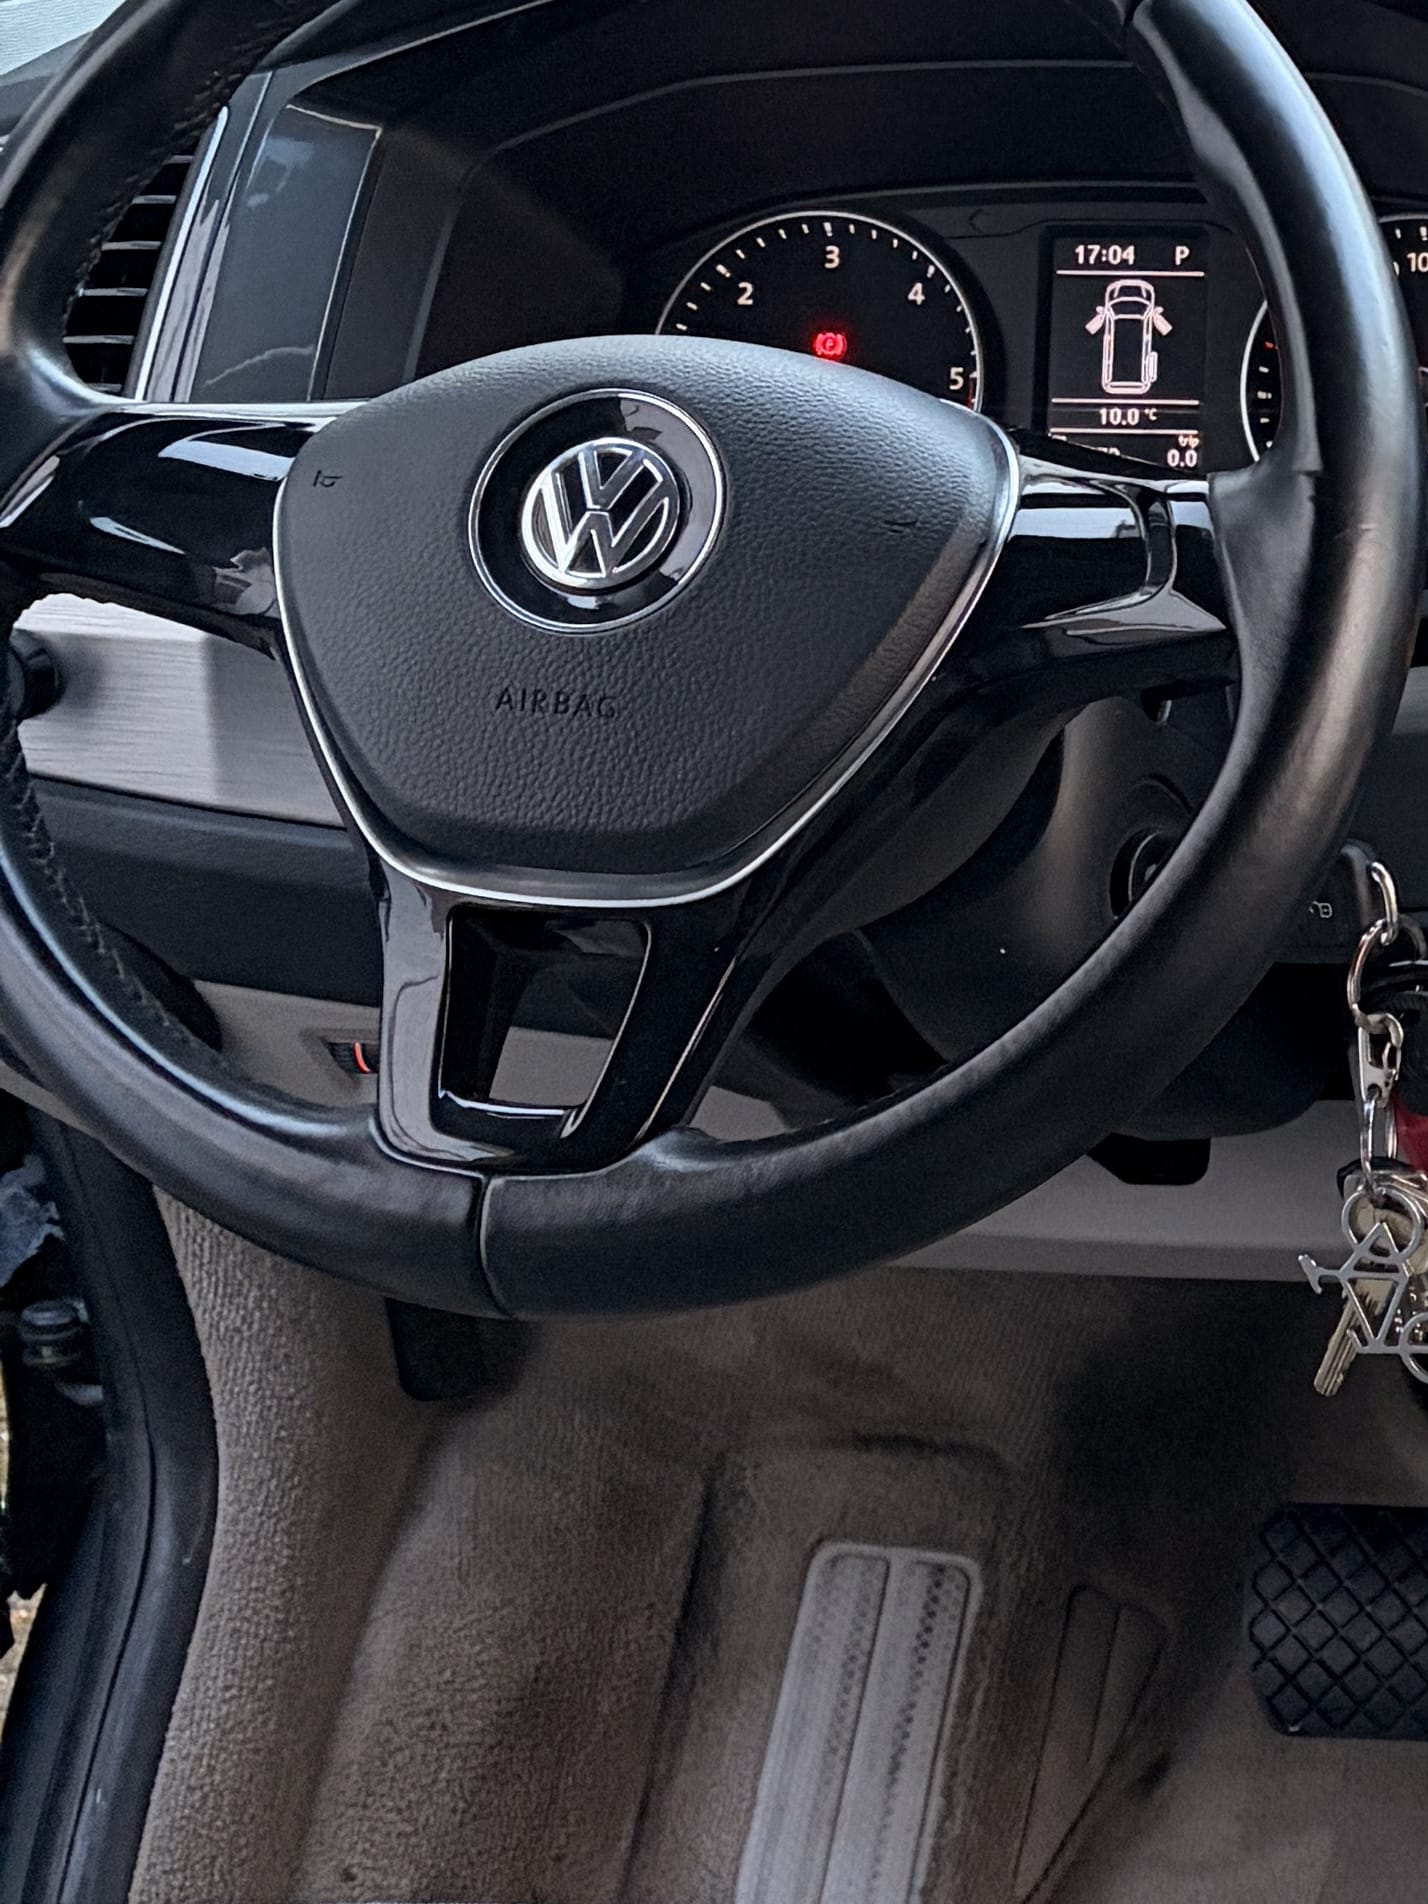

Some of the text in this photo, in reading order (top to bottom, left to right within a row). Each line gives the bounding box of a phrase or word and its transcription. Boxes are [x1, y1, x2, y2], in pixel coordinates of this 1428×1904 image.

[824, 245, 841, 269] 3
[1074, 245, 1190, 266] 17:04 P
[737, 281, 754, 306] 2
[907, 282, 926, 305] 4
[949, 366, 964, 390] 5
[1099, 408, 1140, 426] 10.0
[1178, 435, 1200, 449] trip
[1166, 448, 1198, 467] 0.0
[495, 686, 616, 717] AIRBAG
